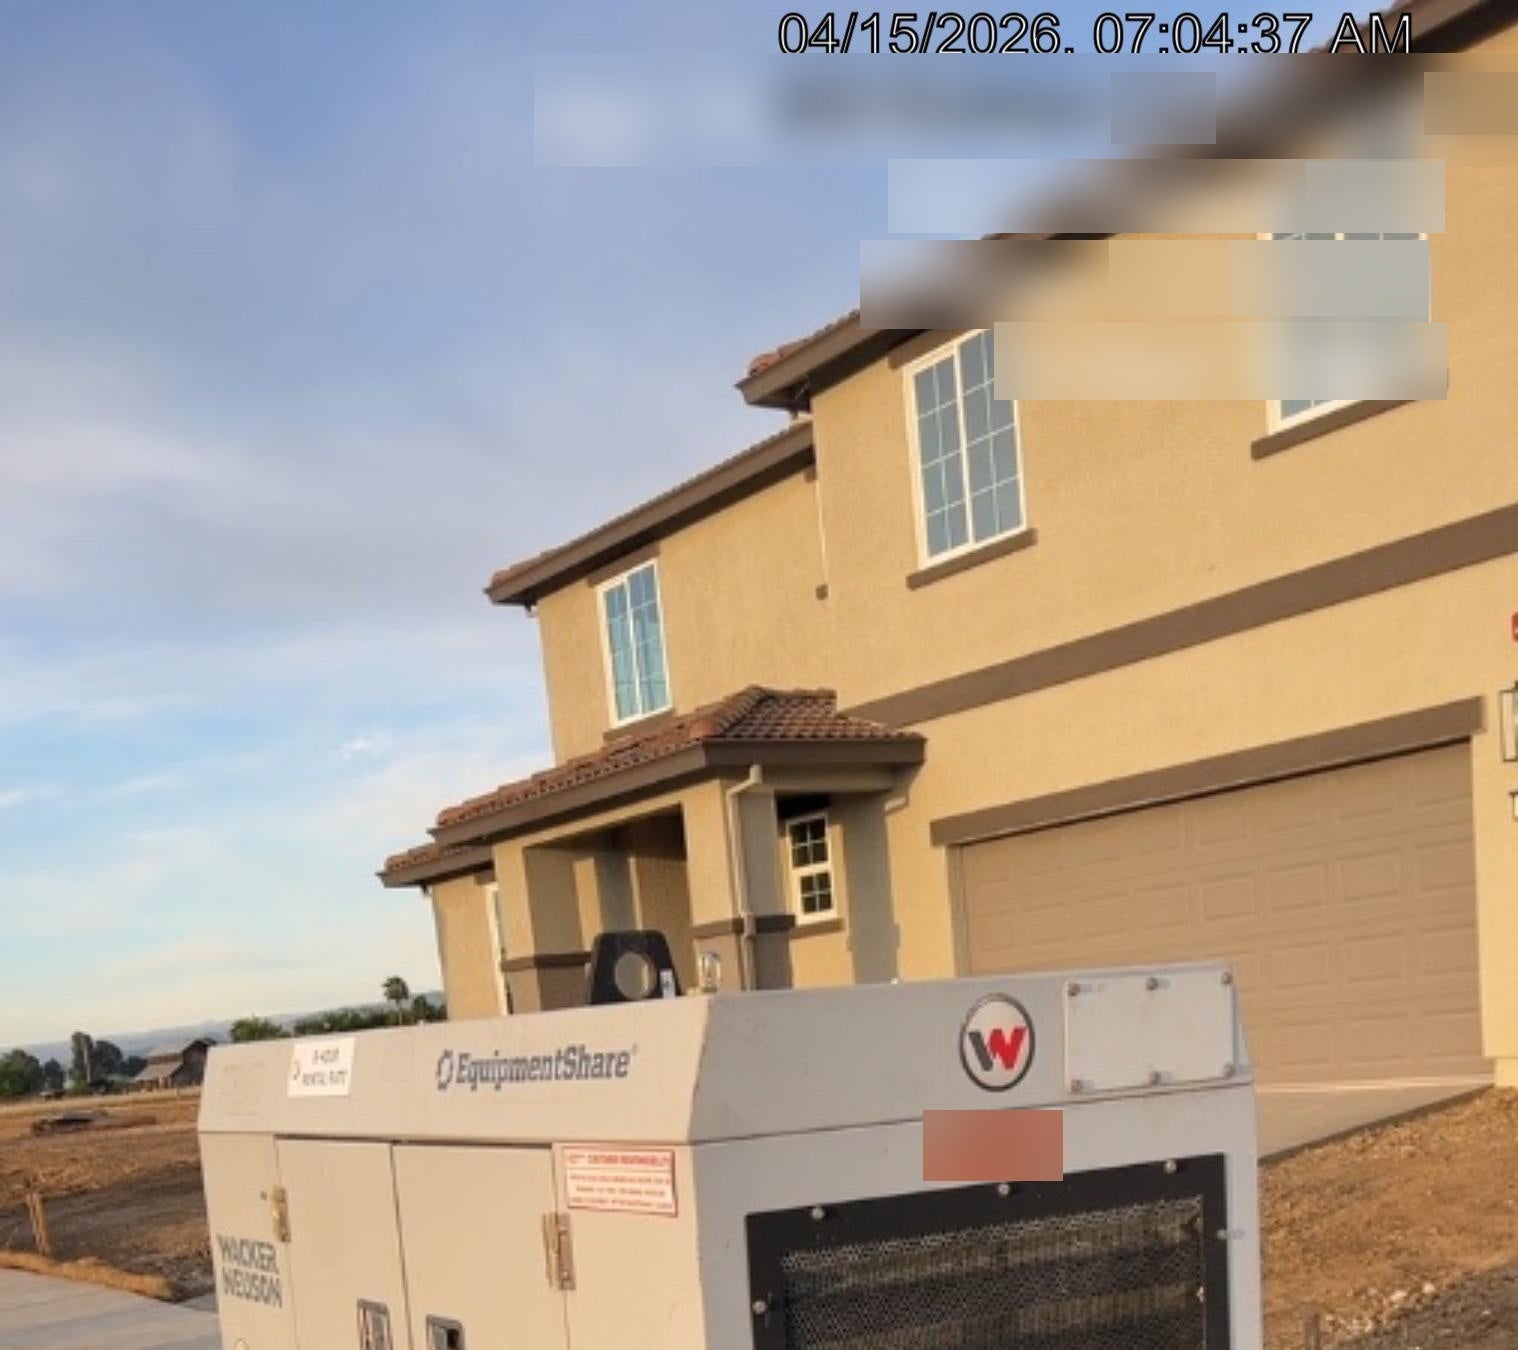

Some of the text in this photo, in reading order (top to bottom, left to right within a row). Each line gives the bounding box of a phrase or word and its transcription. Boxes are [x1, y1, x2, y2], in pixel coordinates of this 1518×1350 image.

[456, 1043, 631, 1092] EquipmentShare
[216, 1232, 280, 1276] WACKER
[221, 1266, 283, 1309] NEUSON
